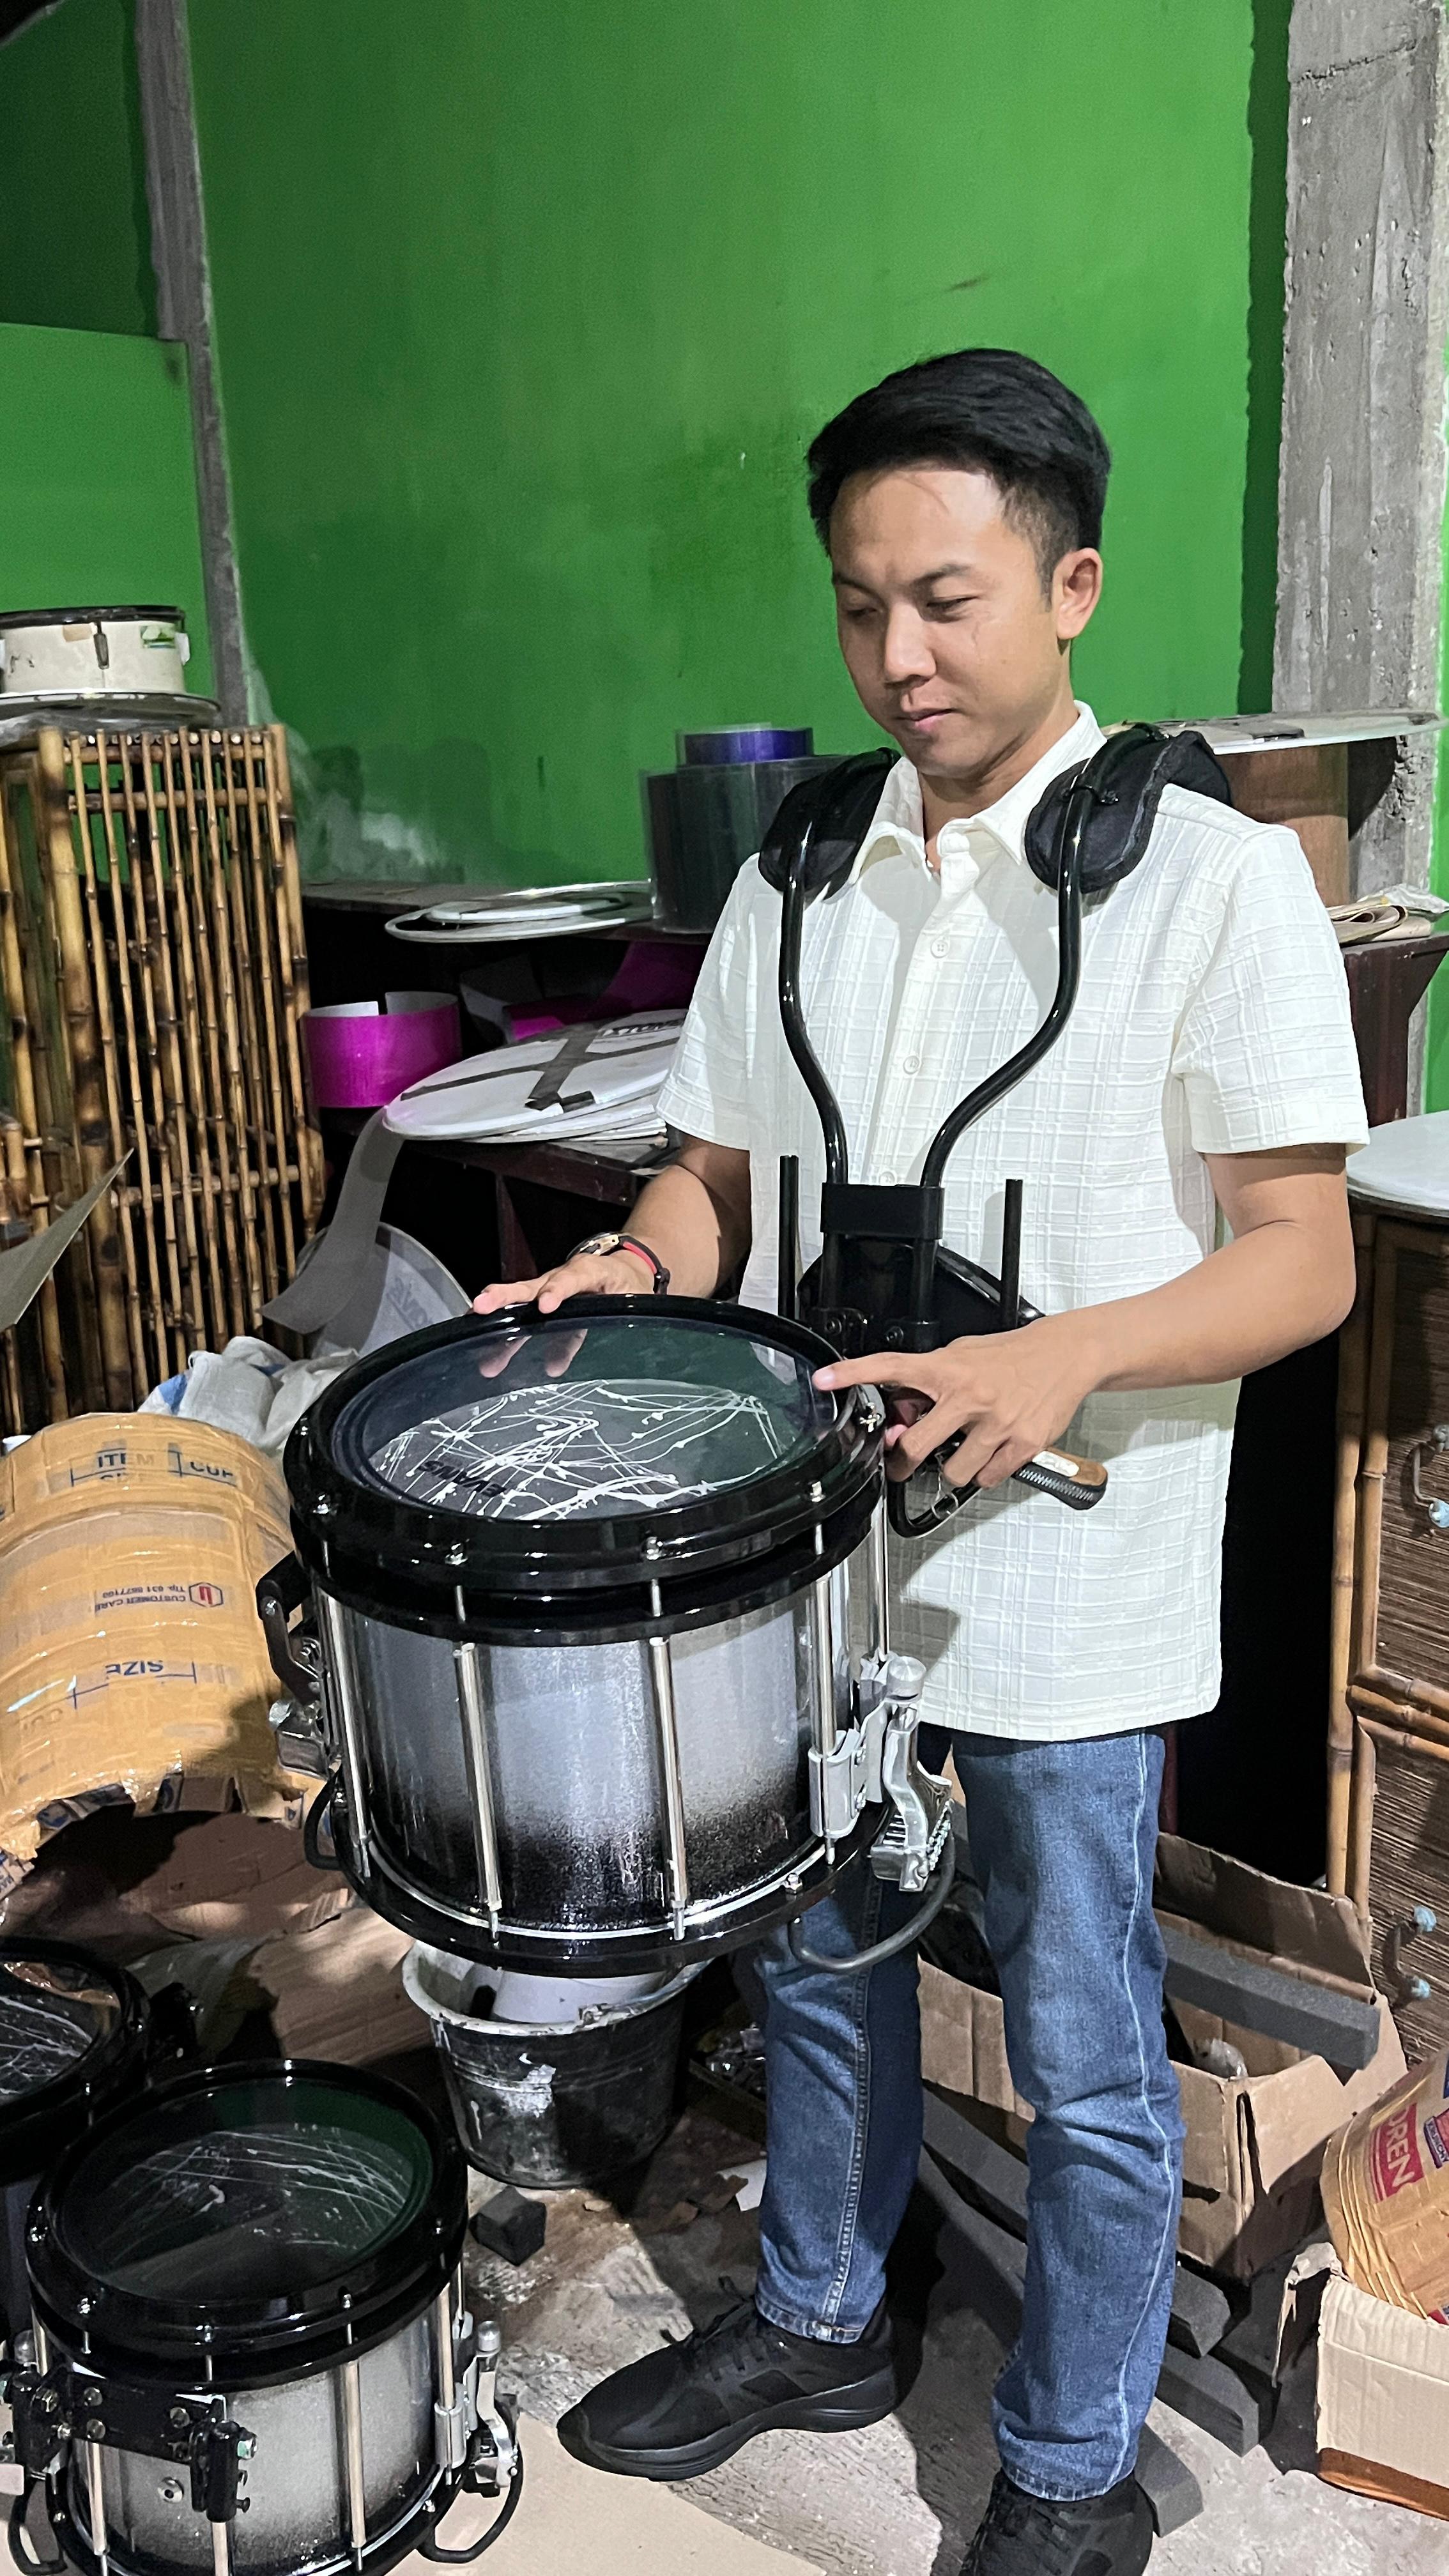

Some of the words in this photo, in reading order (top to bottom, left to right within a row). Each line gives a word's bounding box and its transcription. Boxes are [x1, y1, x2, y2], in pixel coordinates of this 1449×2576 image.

[97, 1452, 155, 1468] ITEM
[418, 1460, 506, 1497] EVANS
[127, 1595, 185, 1604] CUSTOMER
[105, 1660, 164, 1675] SIZE
